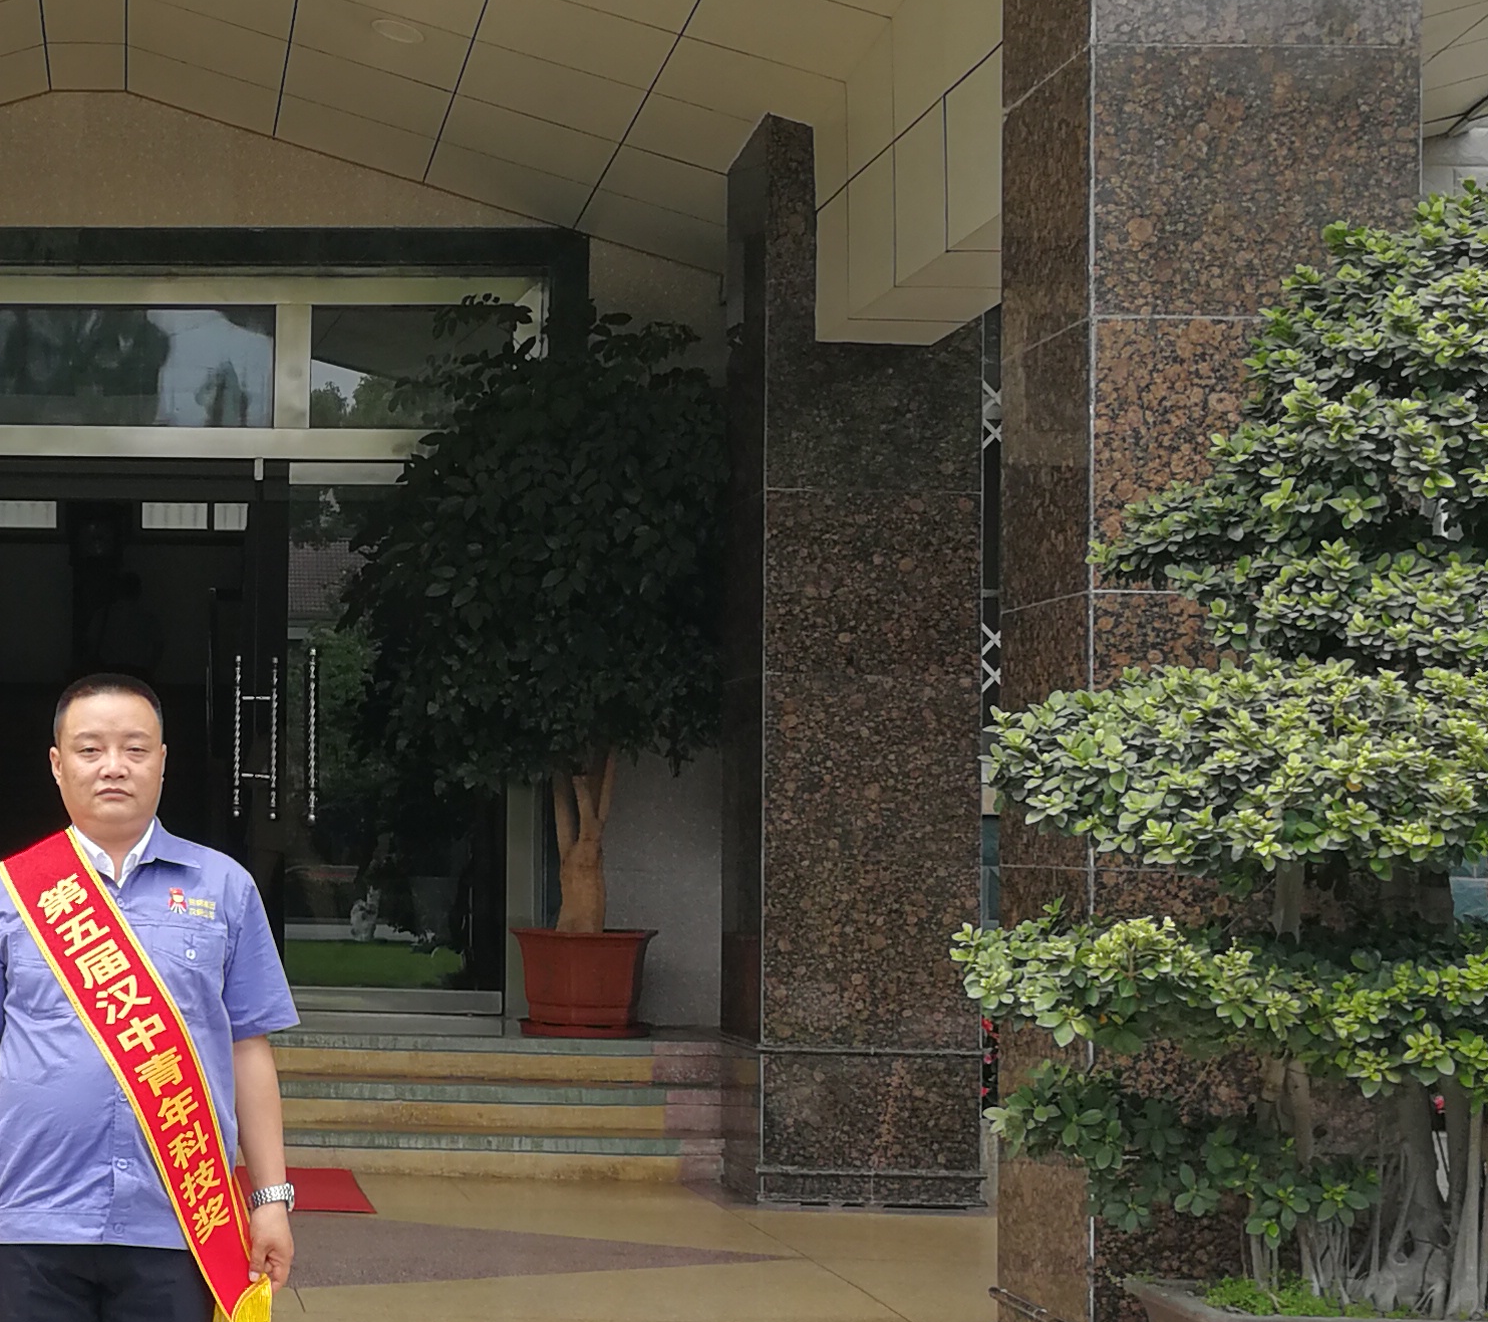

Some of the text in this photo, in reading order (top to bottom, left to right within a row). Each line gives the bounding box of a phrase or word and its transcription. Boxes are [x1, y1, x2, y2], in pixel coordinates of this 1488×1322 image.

[37, 873, 230, 1245] 第五届汉中青年科技奖
